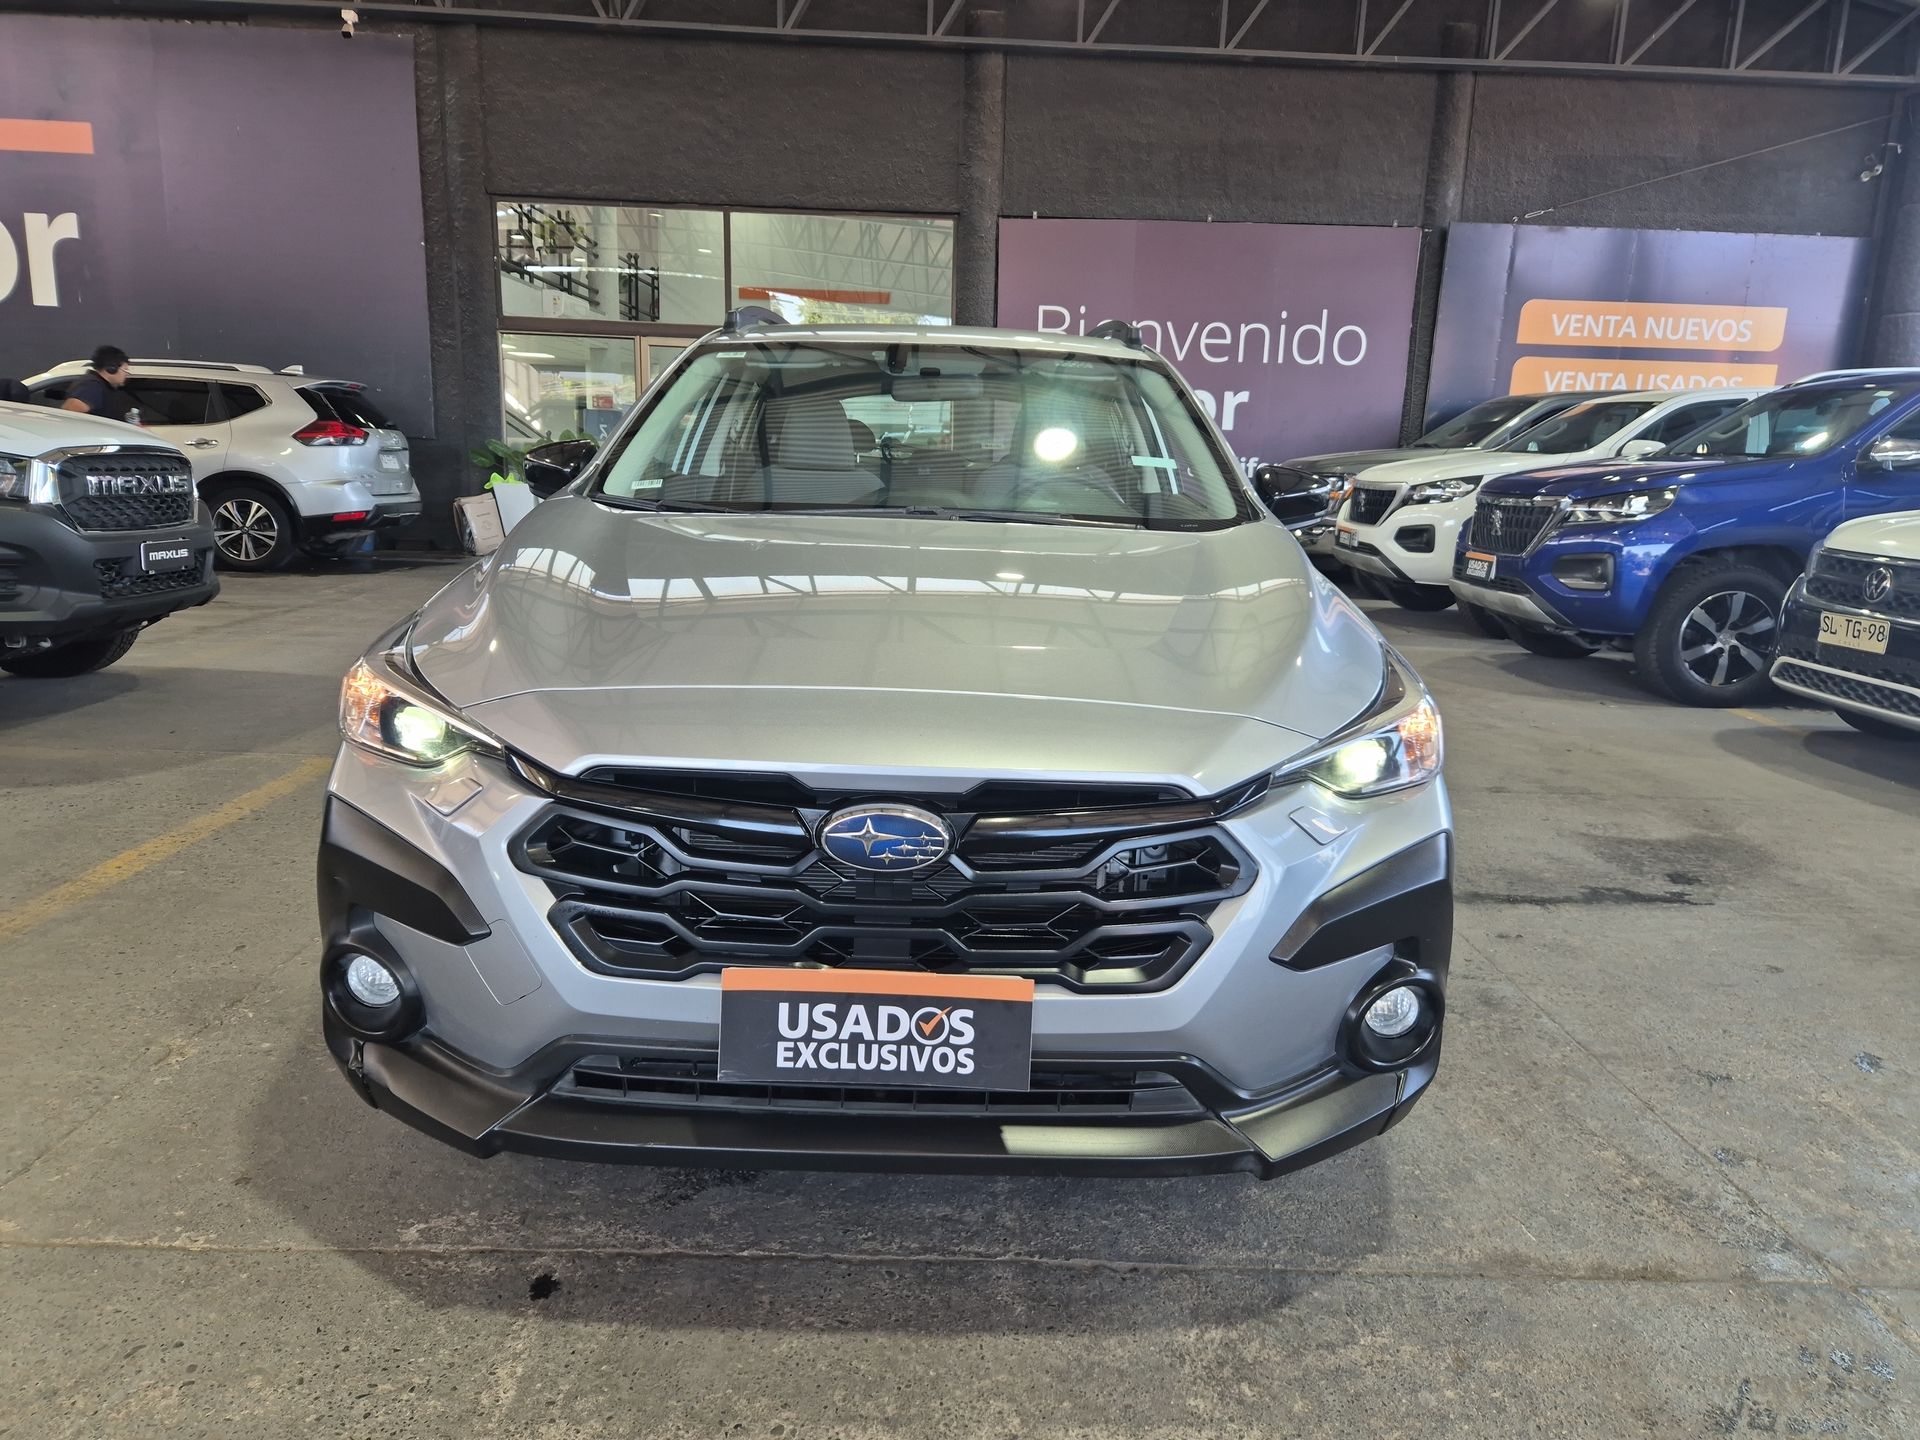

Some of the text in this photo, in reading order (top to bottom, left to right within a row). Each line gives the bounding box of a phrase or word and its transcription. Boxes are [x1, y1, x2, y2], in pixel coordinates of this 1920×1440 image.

[1038, 305, 1367, 366] Binvenido
[1552, 314, 1752, 343] VENTA NUEVOS
[1544, 371, 1627, 392] VENTA
[86, 475, 188, 495] MAXUS
[149, 549, 189, 561] MAXUS
[777, 1002, 975, 1045] USADOS
[776, 1041, 975, 1074] EXCLUSIVOS
